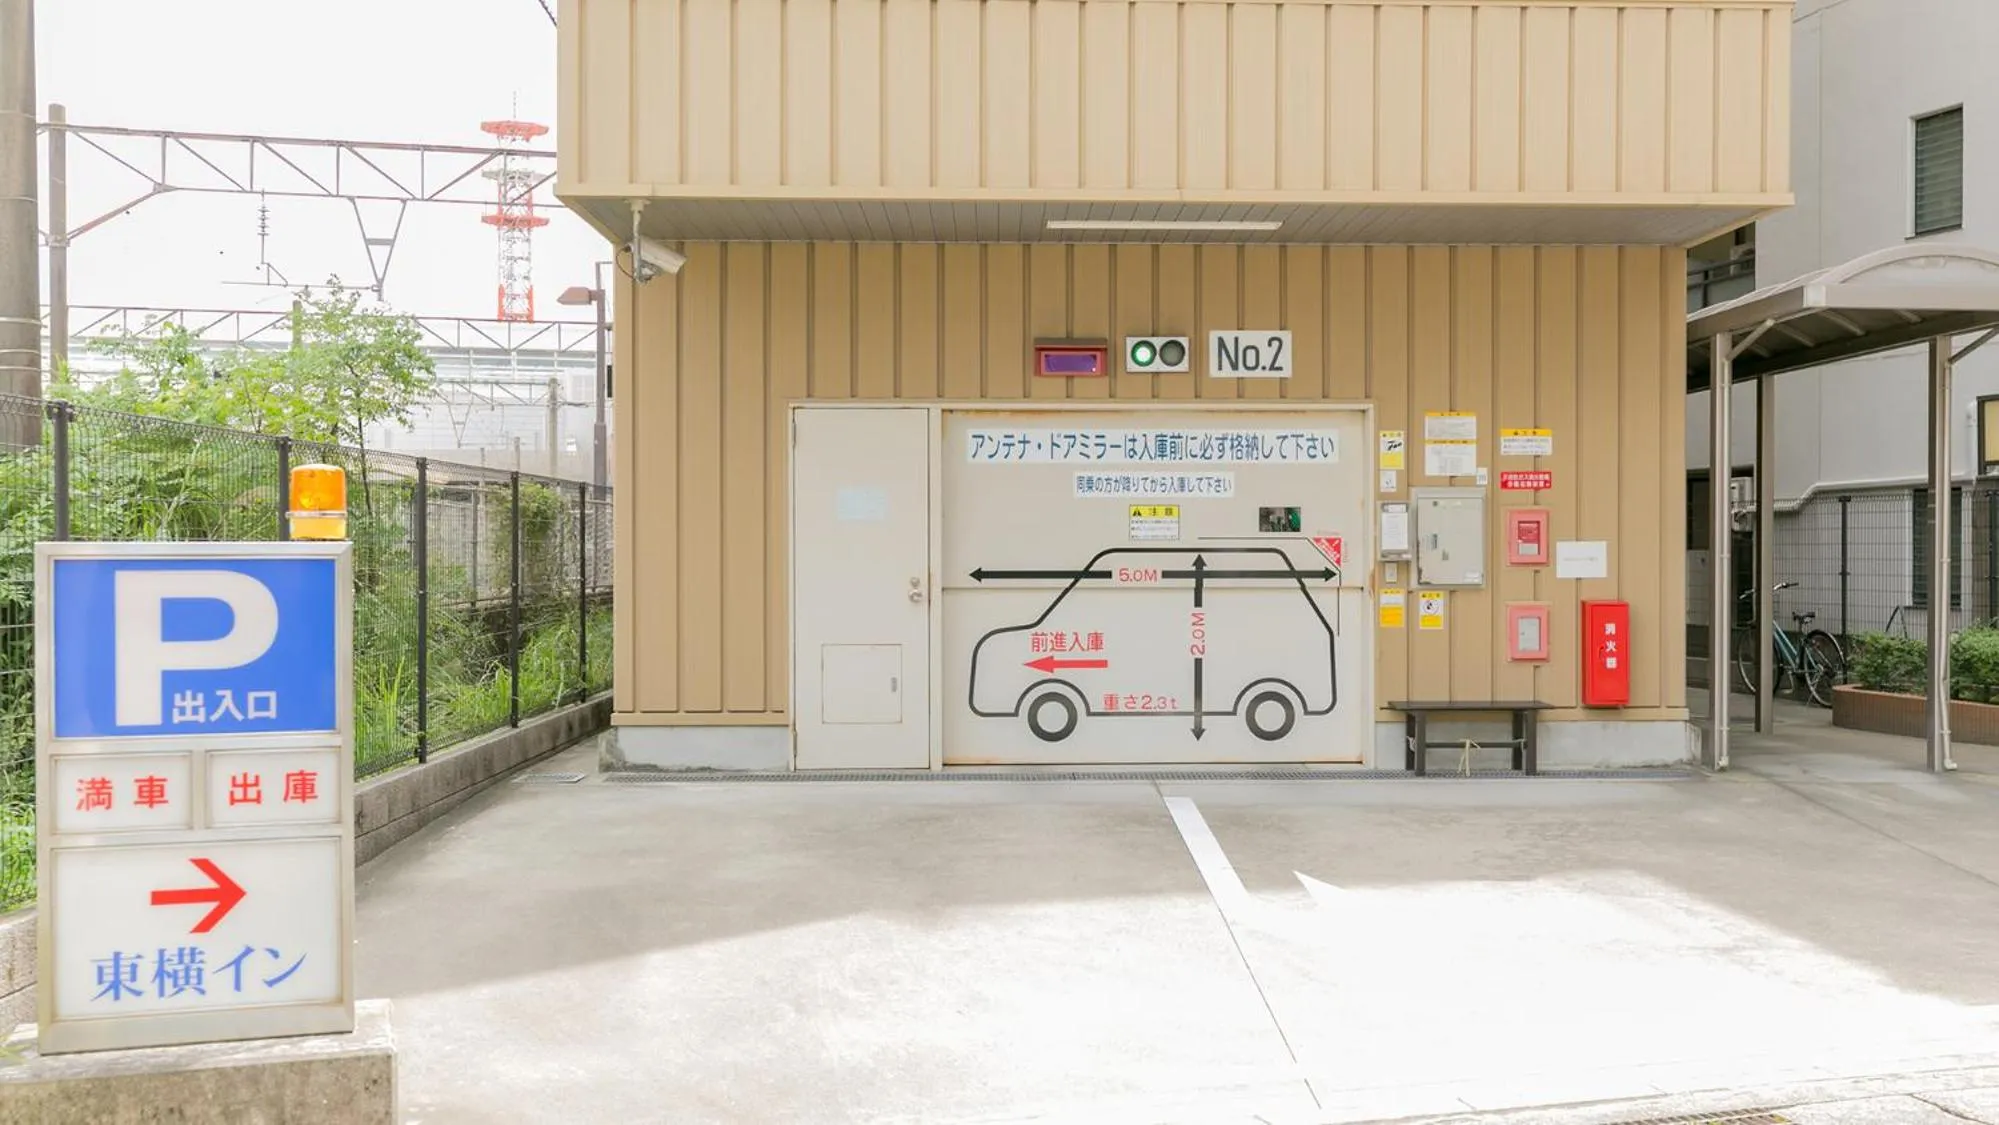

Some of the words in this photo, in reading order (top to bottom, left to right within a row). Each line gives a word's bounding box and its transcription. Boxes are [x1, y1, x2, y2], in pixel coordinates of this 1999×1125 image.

[1217, 336, 1284, 372] No.2
[970, 432, 1335, 461] アンテナ・ドアミラーは入庫前に必ず格納して下さい
[1075, 475, 1233, 494] 同乗の方が降りてから入庫して下さい
[1118, 567, 1158, 582] 5.0M
[115, 569, 279, 727] P
[1029, 632, 1105, 653] 前進入庫
[1190, 611, 1206, 657] 2.0M
[171, 689, 278, 725] 出入口
[75, 774, 170, 813] 満車
[227, 769, 319, 807] 出庫
[89, 944, 308, 1003] 東横イン
